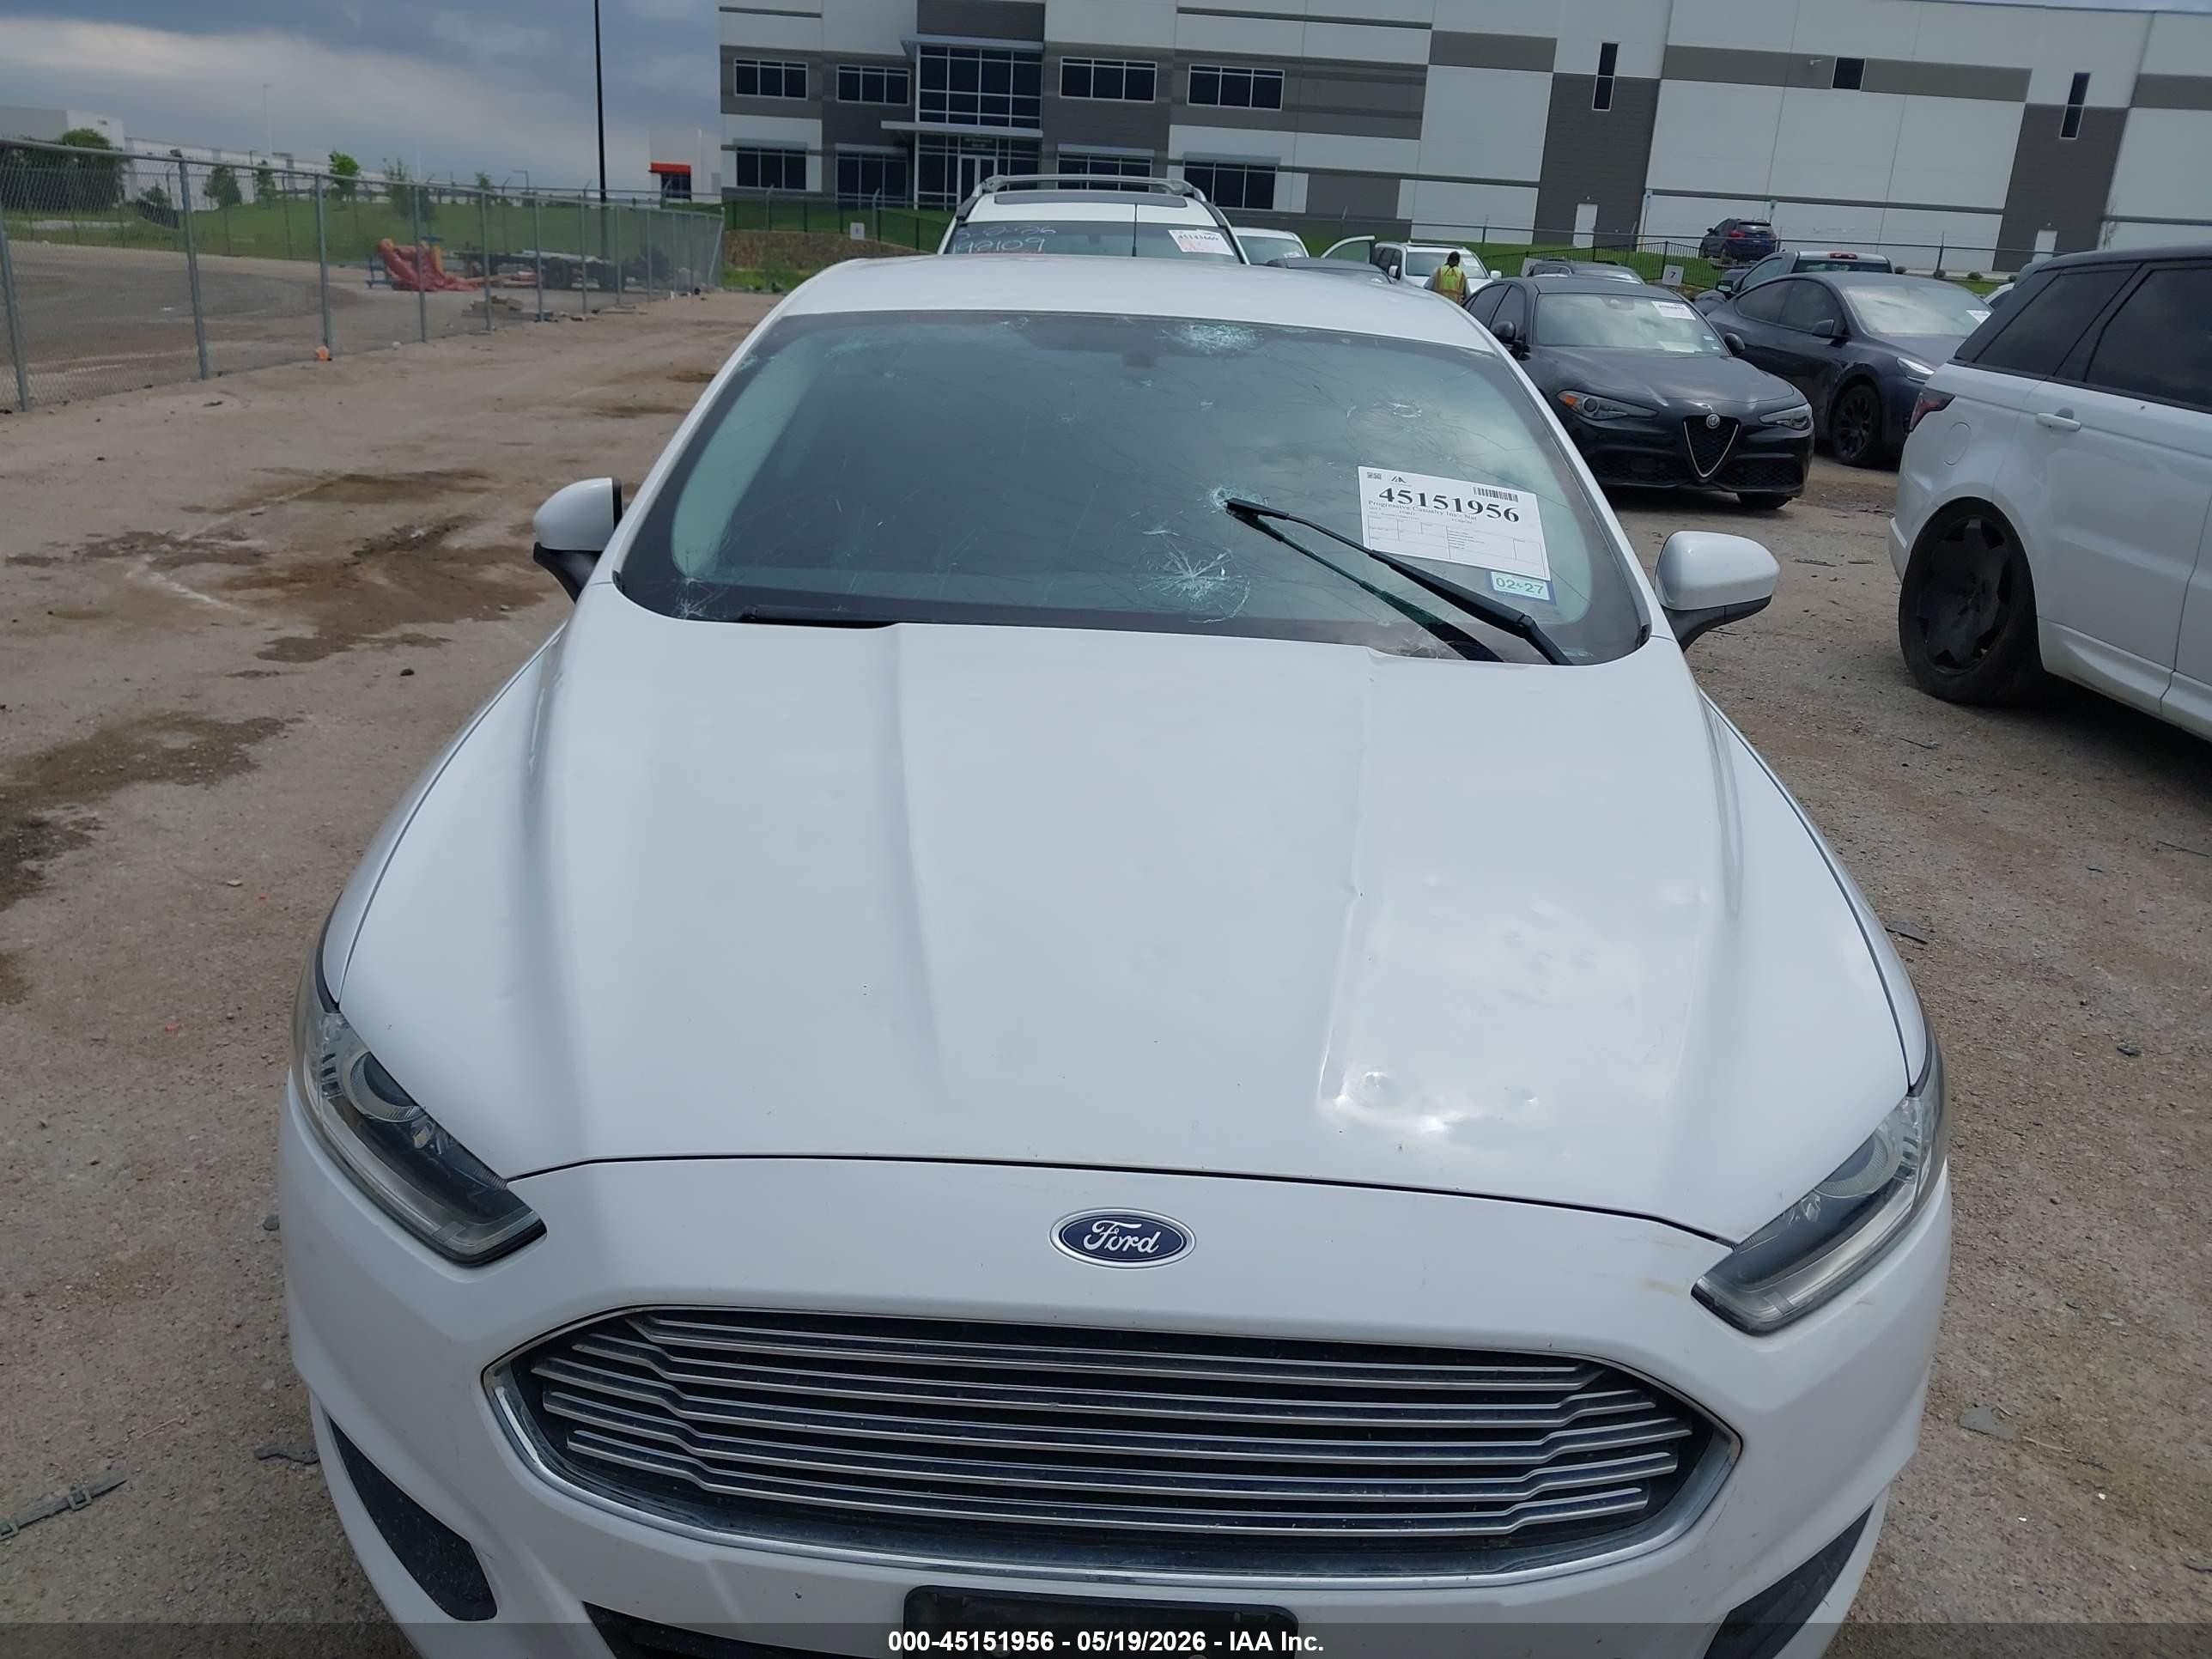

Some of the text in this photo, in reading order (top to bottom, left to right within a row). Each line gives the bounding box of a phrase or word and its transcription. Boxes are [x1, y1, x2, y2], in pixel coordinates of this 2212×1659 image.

[1368, 500, 1411, 511] Progressive
[1413, 506, 1444, 516] Casualty
[1378, 487, 1520, 523] 45151956
[1083, 1220, 1162, 1254] Ford
